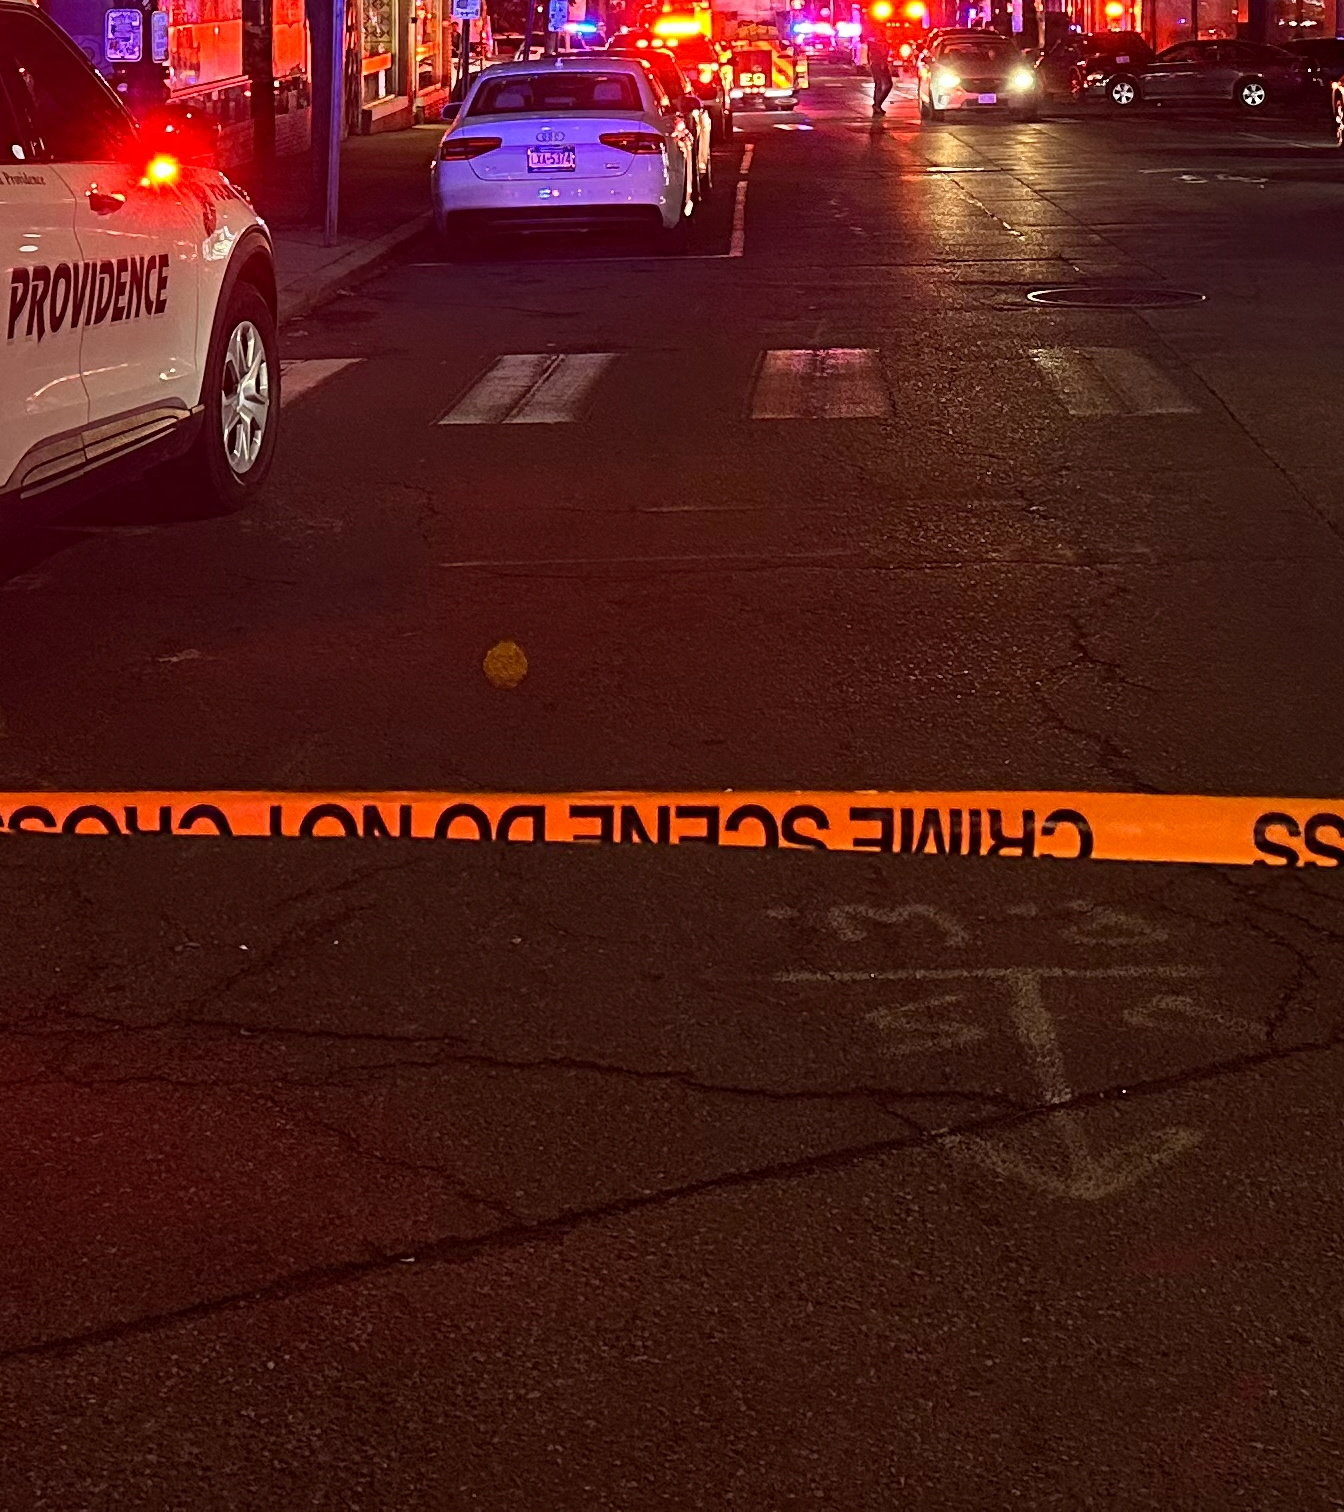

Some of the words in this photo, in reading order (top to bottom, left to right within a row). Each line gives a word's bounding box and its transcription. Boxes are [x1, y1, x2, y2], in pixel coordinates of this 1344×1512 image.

[2, 171, 47, 186] Providence
[7, 253, 170, 344] PROVIDENCE
[568, 803, 831, 850] SCENE
[850, 806, 1094, 859] CRIME
